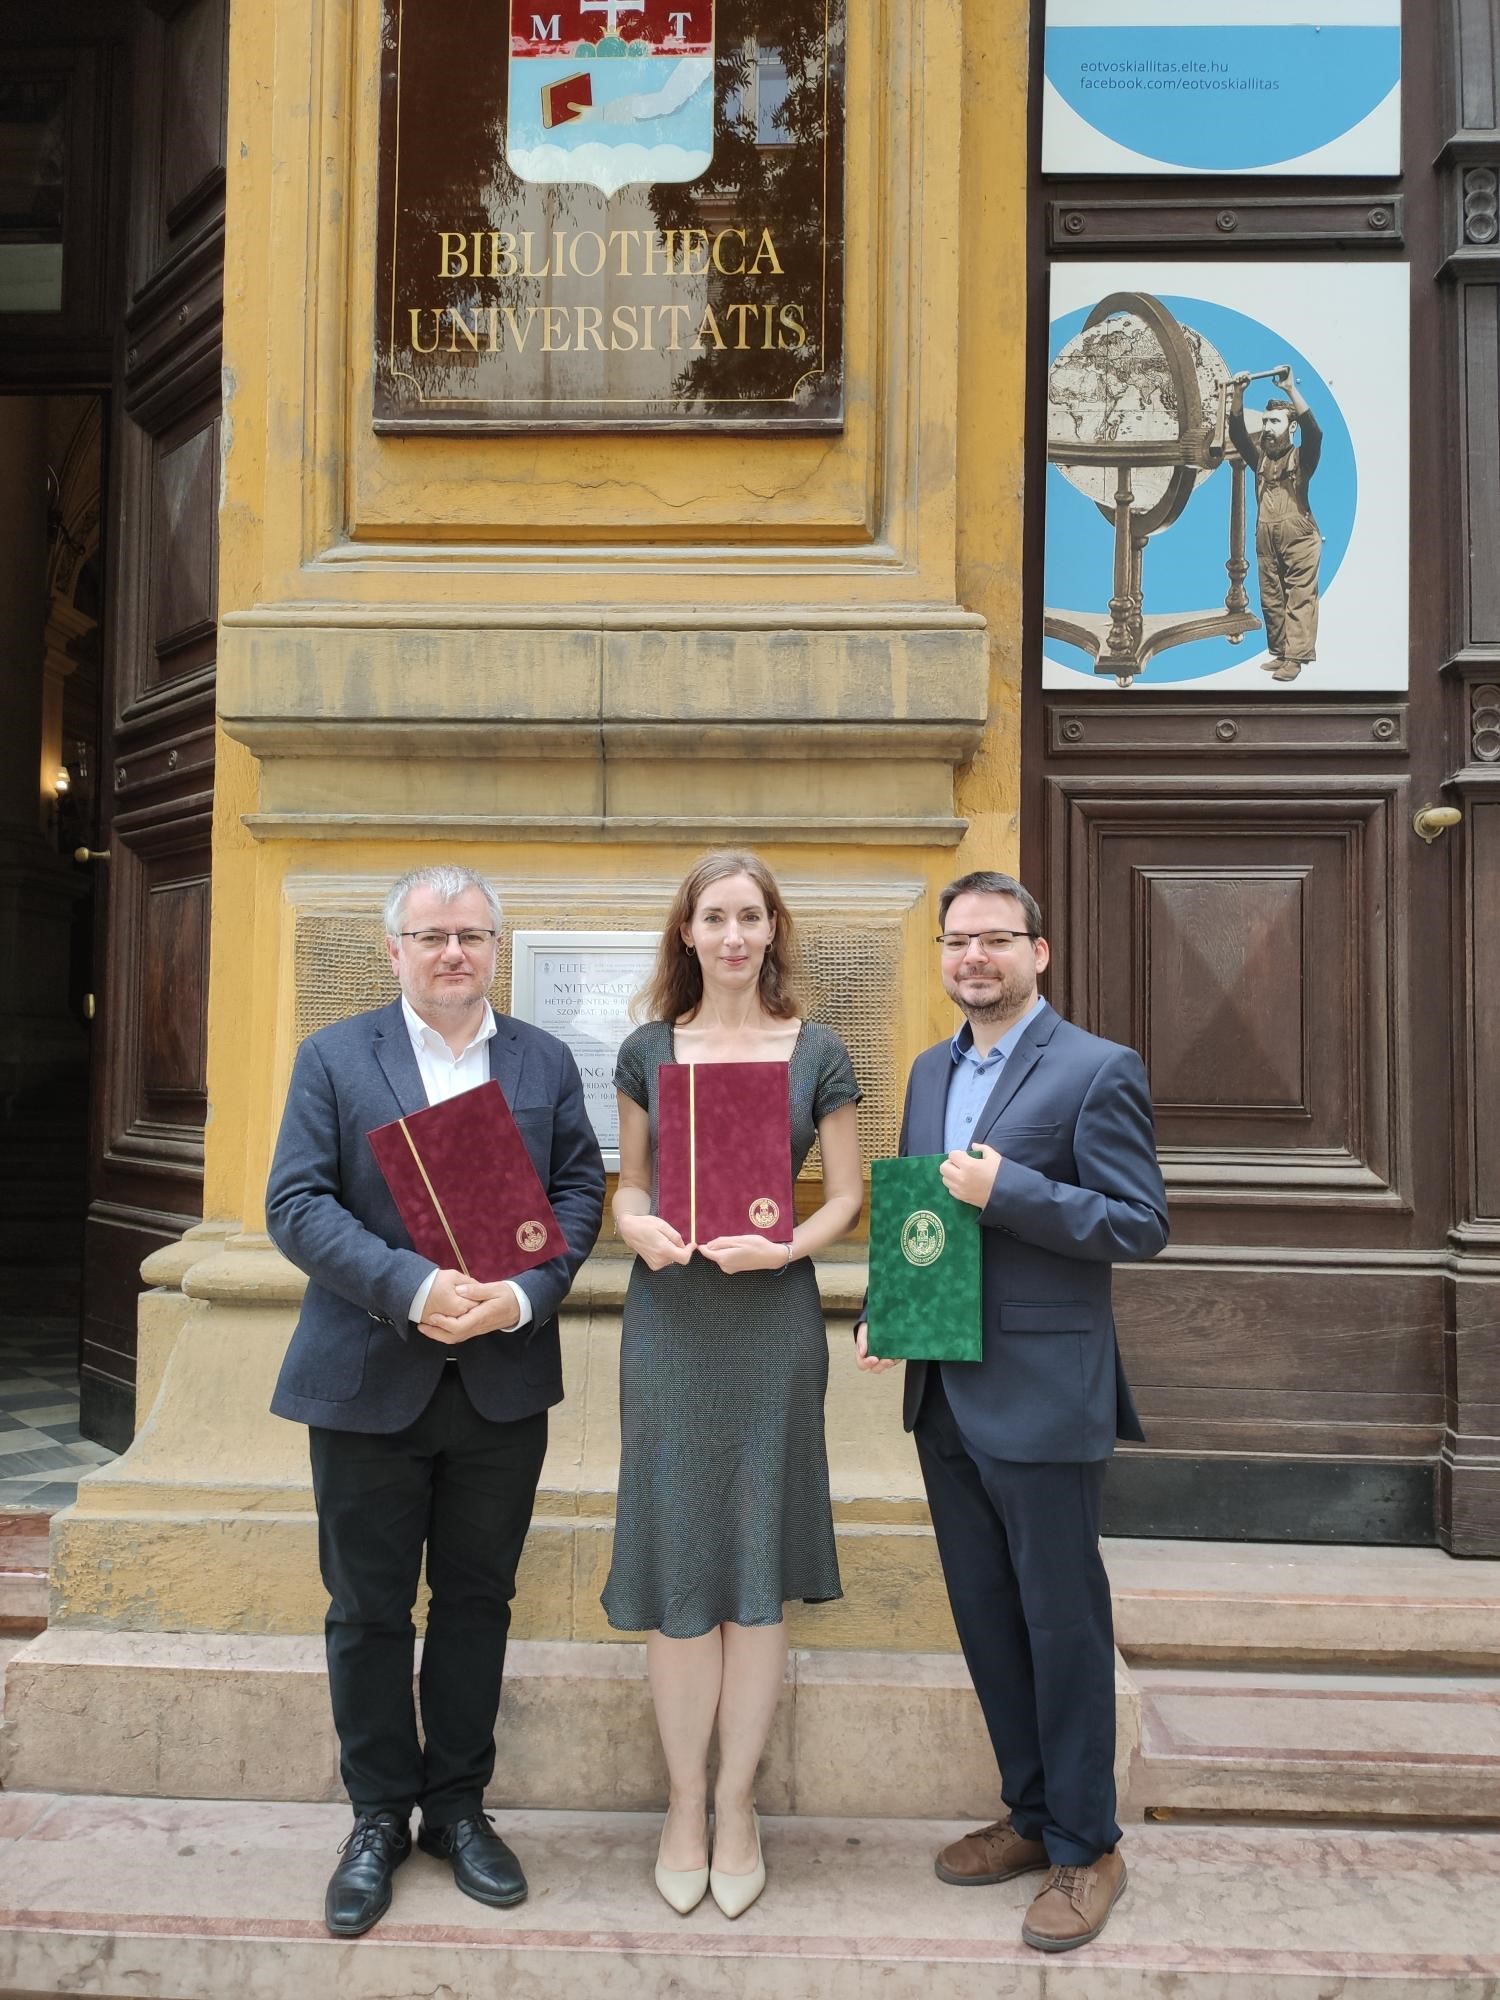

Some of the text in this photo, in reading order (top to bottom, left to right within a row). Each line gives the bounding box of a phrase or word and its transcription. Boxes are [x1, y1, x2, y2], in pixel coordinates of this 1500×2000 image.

[530, 14, 562, 41] M
[668, 12, 692, 39] T
[1080, 60, 1229, 73] eotvoskiallitas.elte.hu
[1080, 77, 1280, 90] facebook.com/eotvoskiallitas
[437, 227, 785, 278] BIBLIOTHECA
[408, 303, 806, 353] UNIVERSITATIS
[559, 963, 587, 973] ELTE
